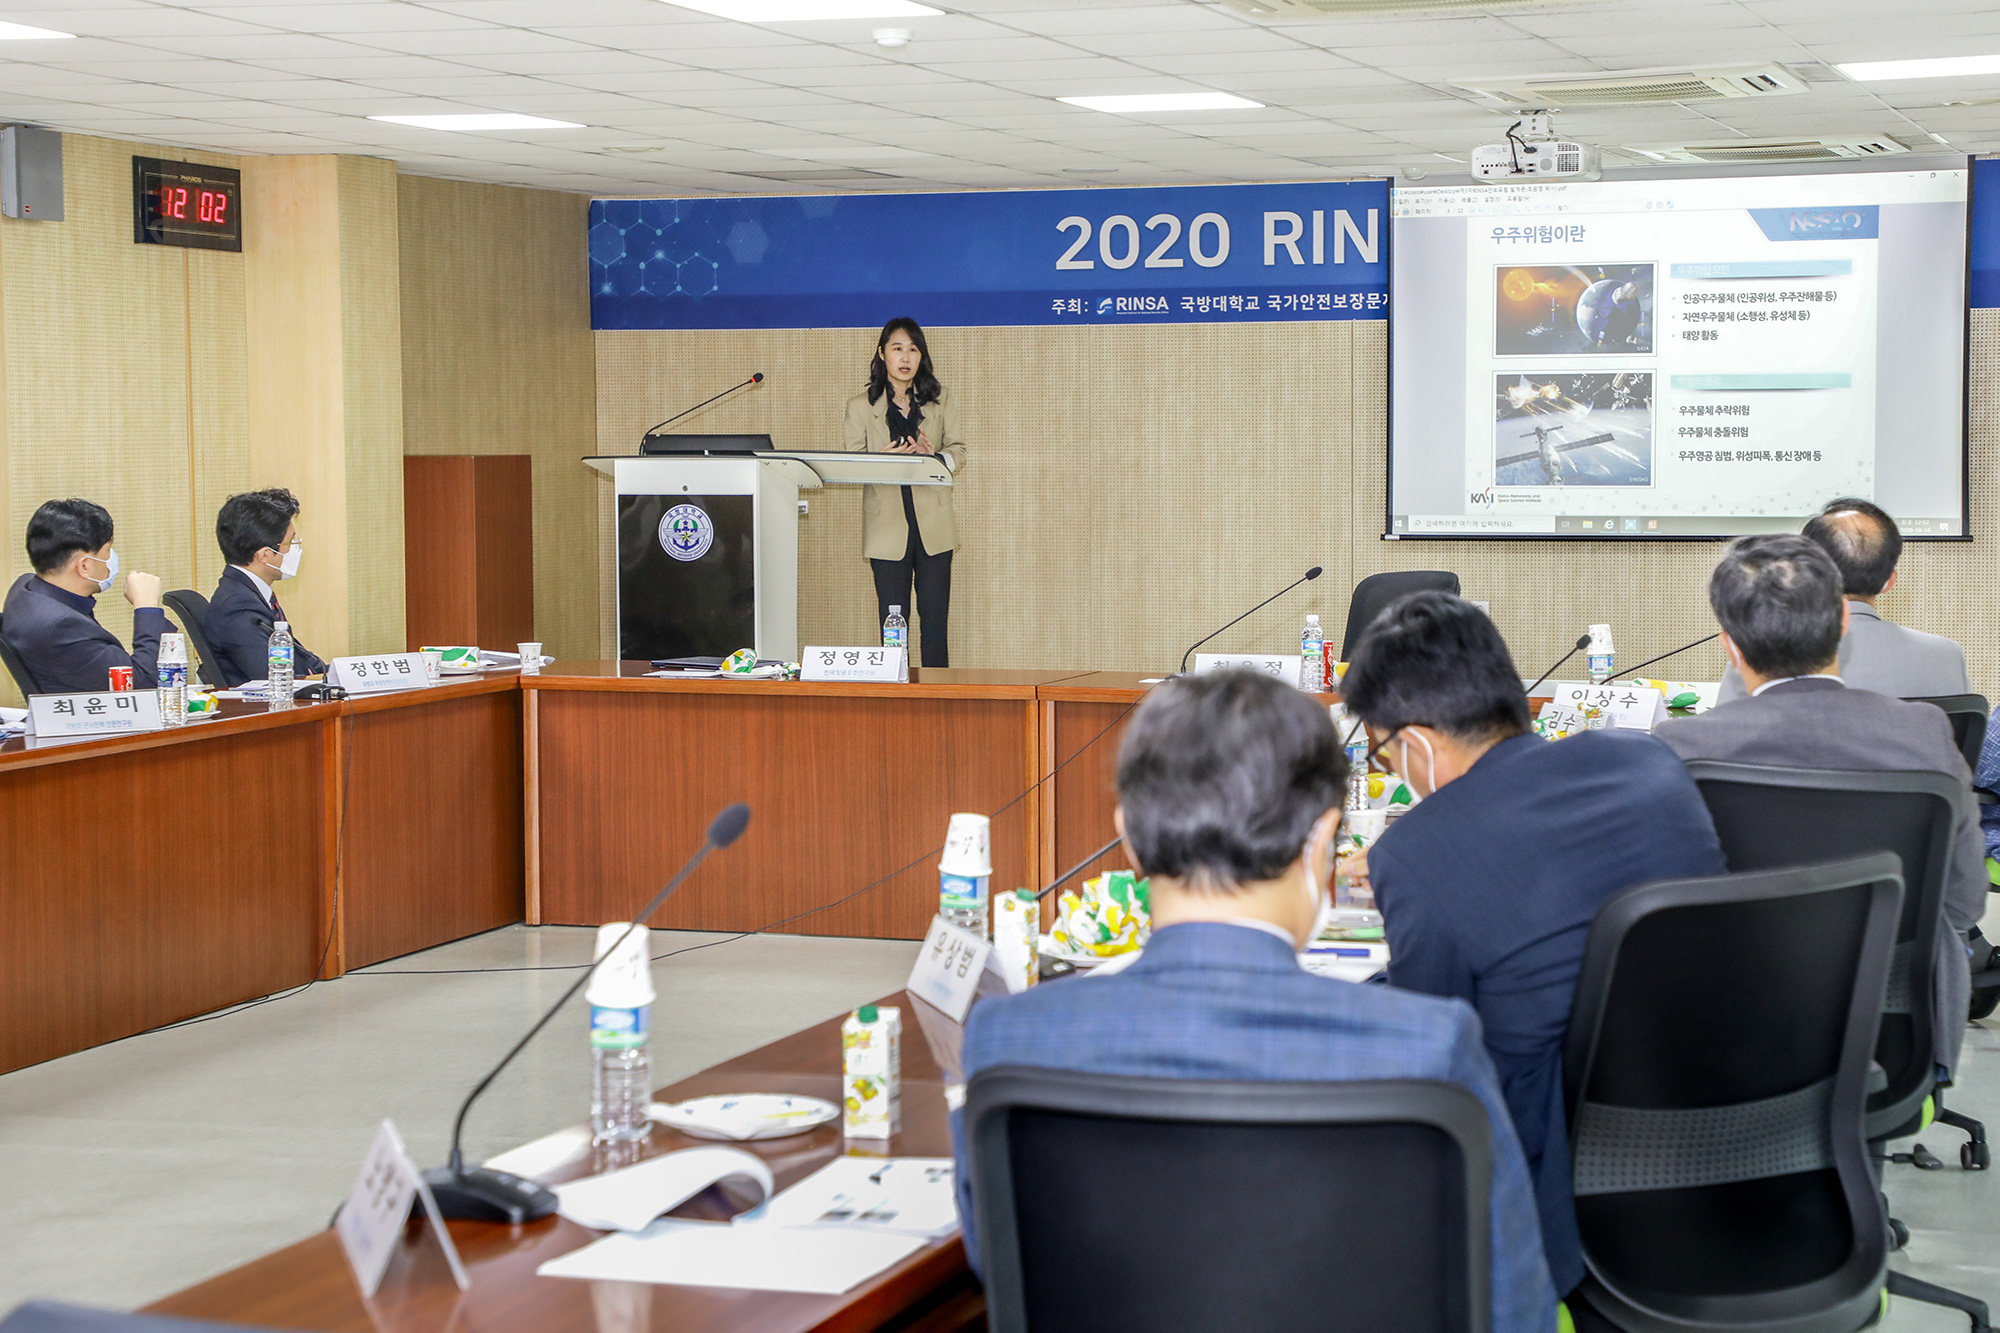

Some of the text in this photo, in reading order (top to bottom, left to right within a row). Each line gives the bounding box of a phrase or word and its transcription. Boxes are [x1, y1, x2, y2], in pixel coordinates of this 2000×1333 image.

[165, 188, 227, 224] 12 02
[1054, 208, 1379, 271] 2020 RIN
[1490, 224, 1586, 244] 우주위험이란
[1051, 297, 1090, 315] 주최:
[1116, 296, 1170, 311] RINSA
[1179, 296, 1261, 313] 국방대학교
[1682, 293, 1735, 304] 인공우주물체
[1778, 291, 1823, 303] 우주잔해물
[1823, 290, 1838, 302] 등)
[1682, 311, 1735, 322] 자연우주물체
[1770, 310, 1797, 321] 유성체
[1797, 309, 1811, 321] 등)
[1682, 330, 1719, 341] 태양 활동
[1678, 405, 1750, 416] 우주물체 추락위험
[1678, 426, 1749, 438] 우주물체 충돌위험
[1678, 451, 1713, 462] 우주영공
[1774, 450, 1793, 462] 통신
[818, 650, 885, 666] 정영진
[350, 658, 411, 678] 정한범
[53, 695, 139, 717] 최윤미
[1571, 689, 1639, 709] 이상수
